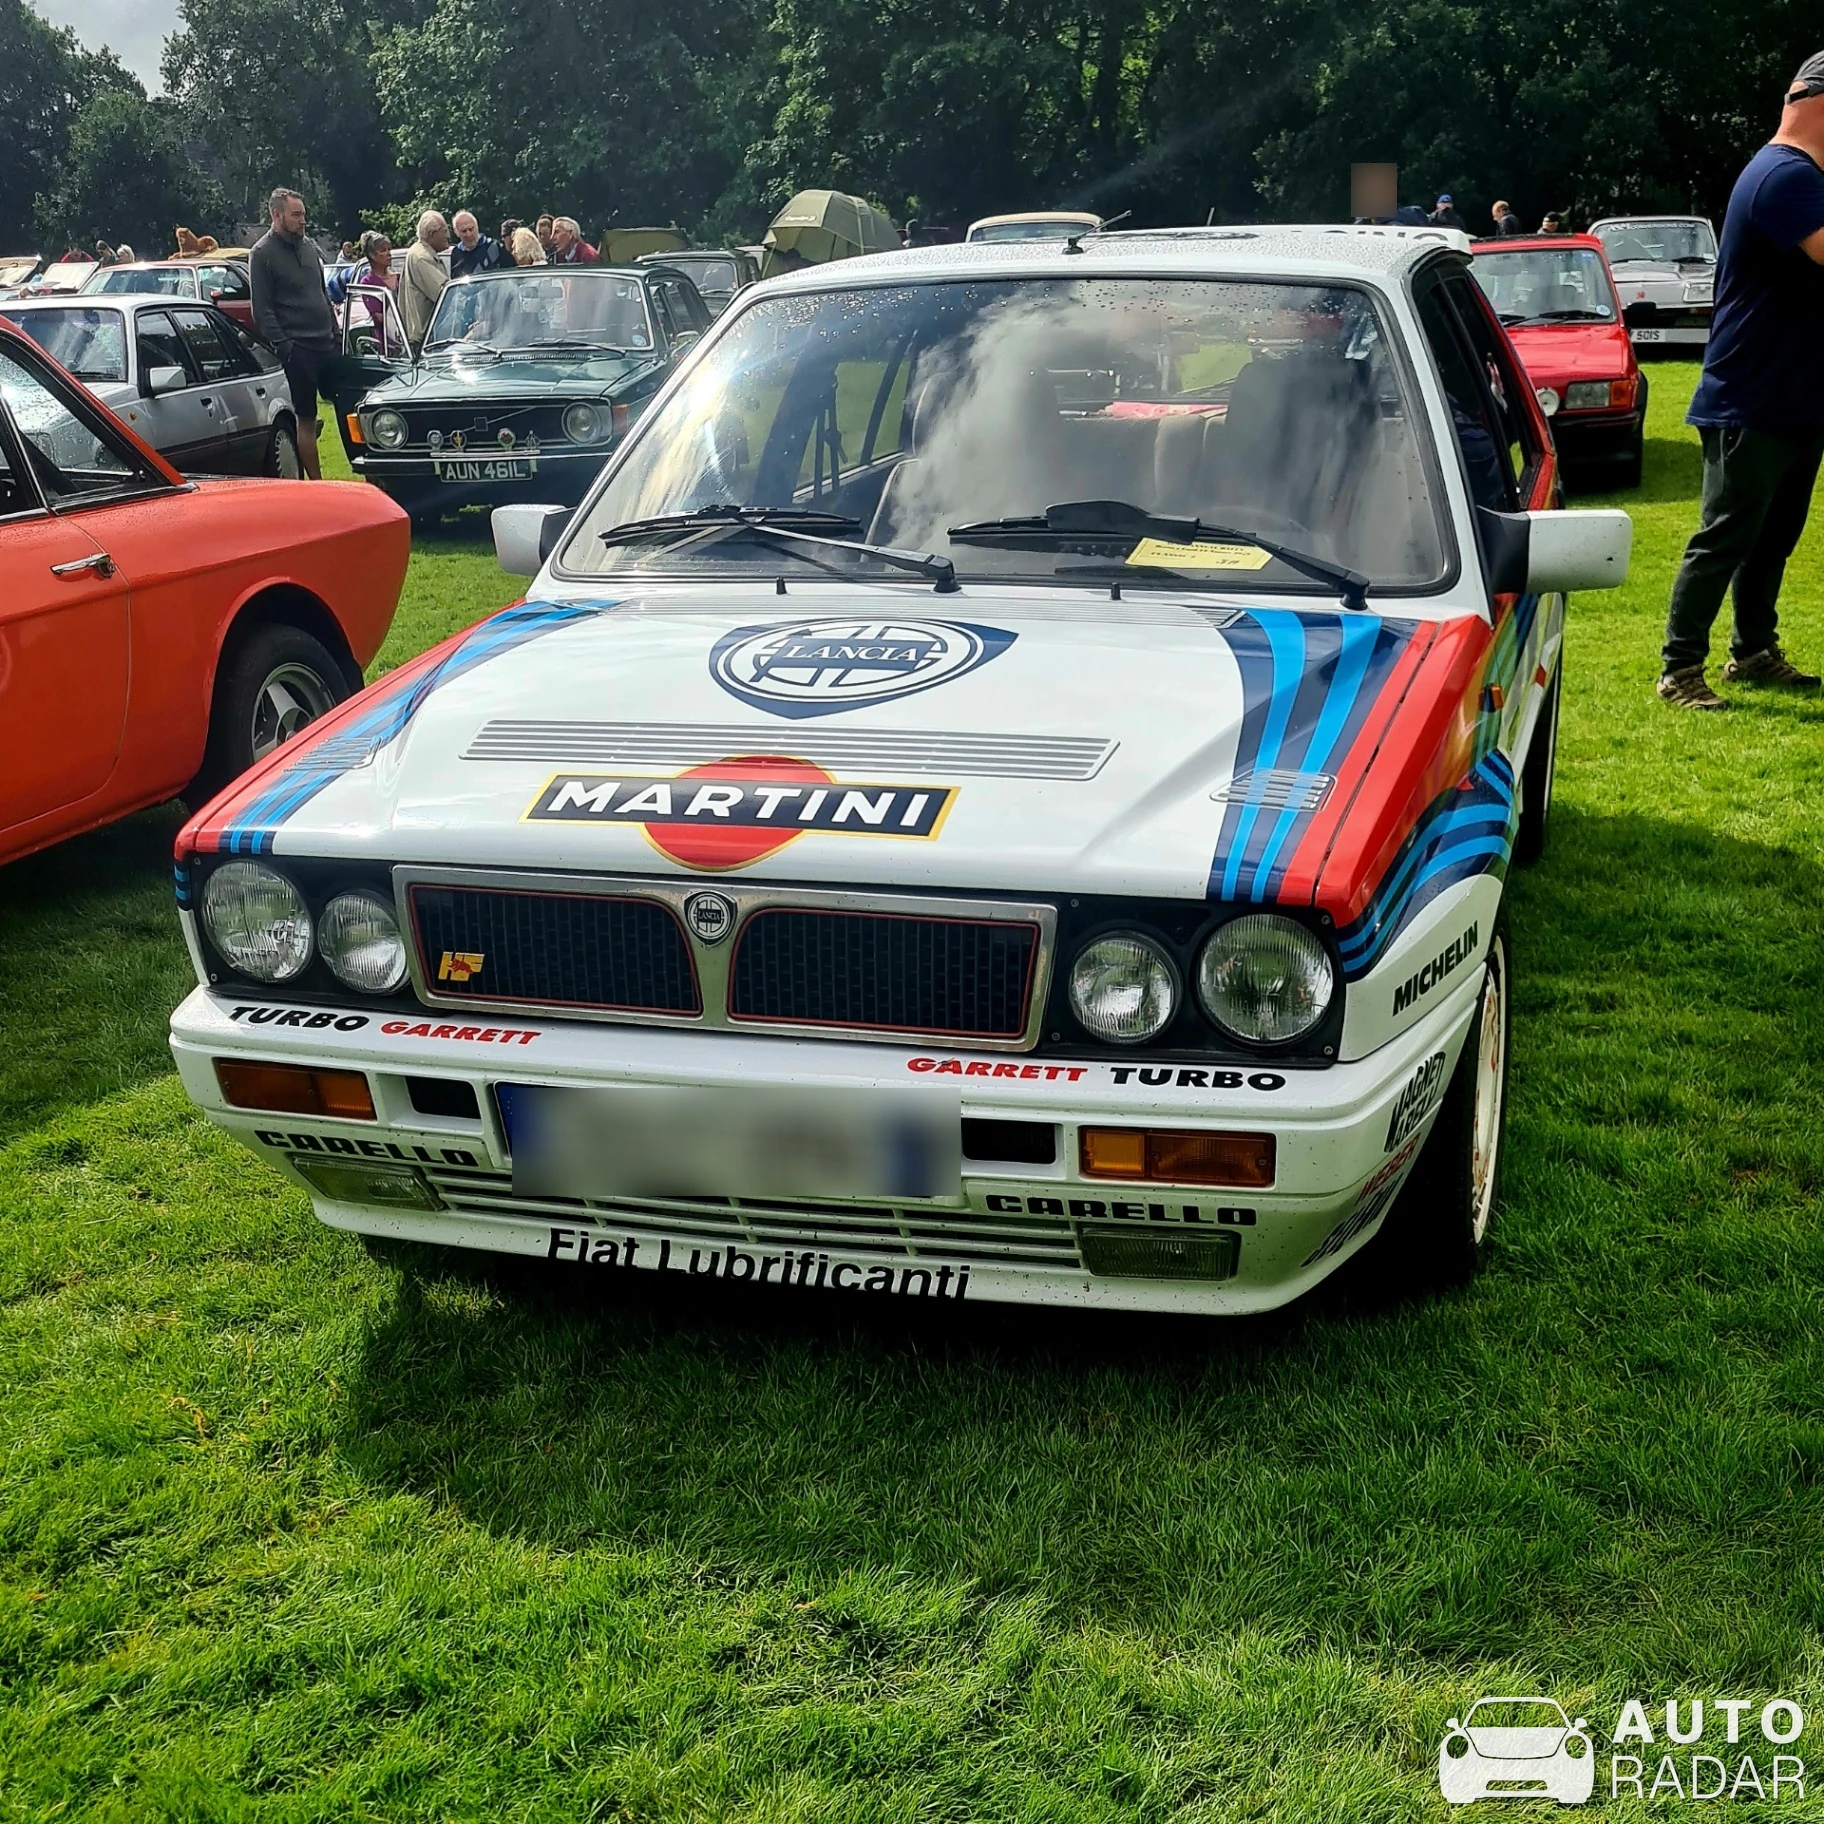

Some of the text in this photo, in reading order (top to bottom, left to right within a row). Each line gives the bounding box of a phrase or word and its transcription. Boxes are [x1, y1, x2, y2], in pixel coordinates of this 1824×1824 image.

[446, 461, 526, 479] AUN 461L
[783, 644, 918, 662] LANCIA
[546, 781, 930, 828] MARTINI
[698, 910, 721, 922] LANCIA
[1392, 920, 1479, 1017] MICHELIN
[229, 1006, 542, 1046] TURBO GARRETT
[907, 1057, 1286, 1091] GARRETT TURBO
[254, 1130, 479, 1167] CARELLO
[985, 1195, 1257, 1226] CARELLO
[548, 1227, 970, 1299] Fiat Lubrificanti
